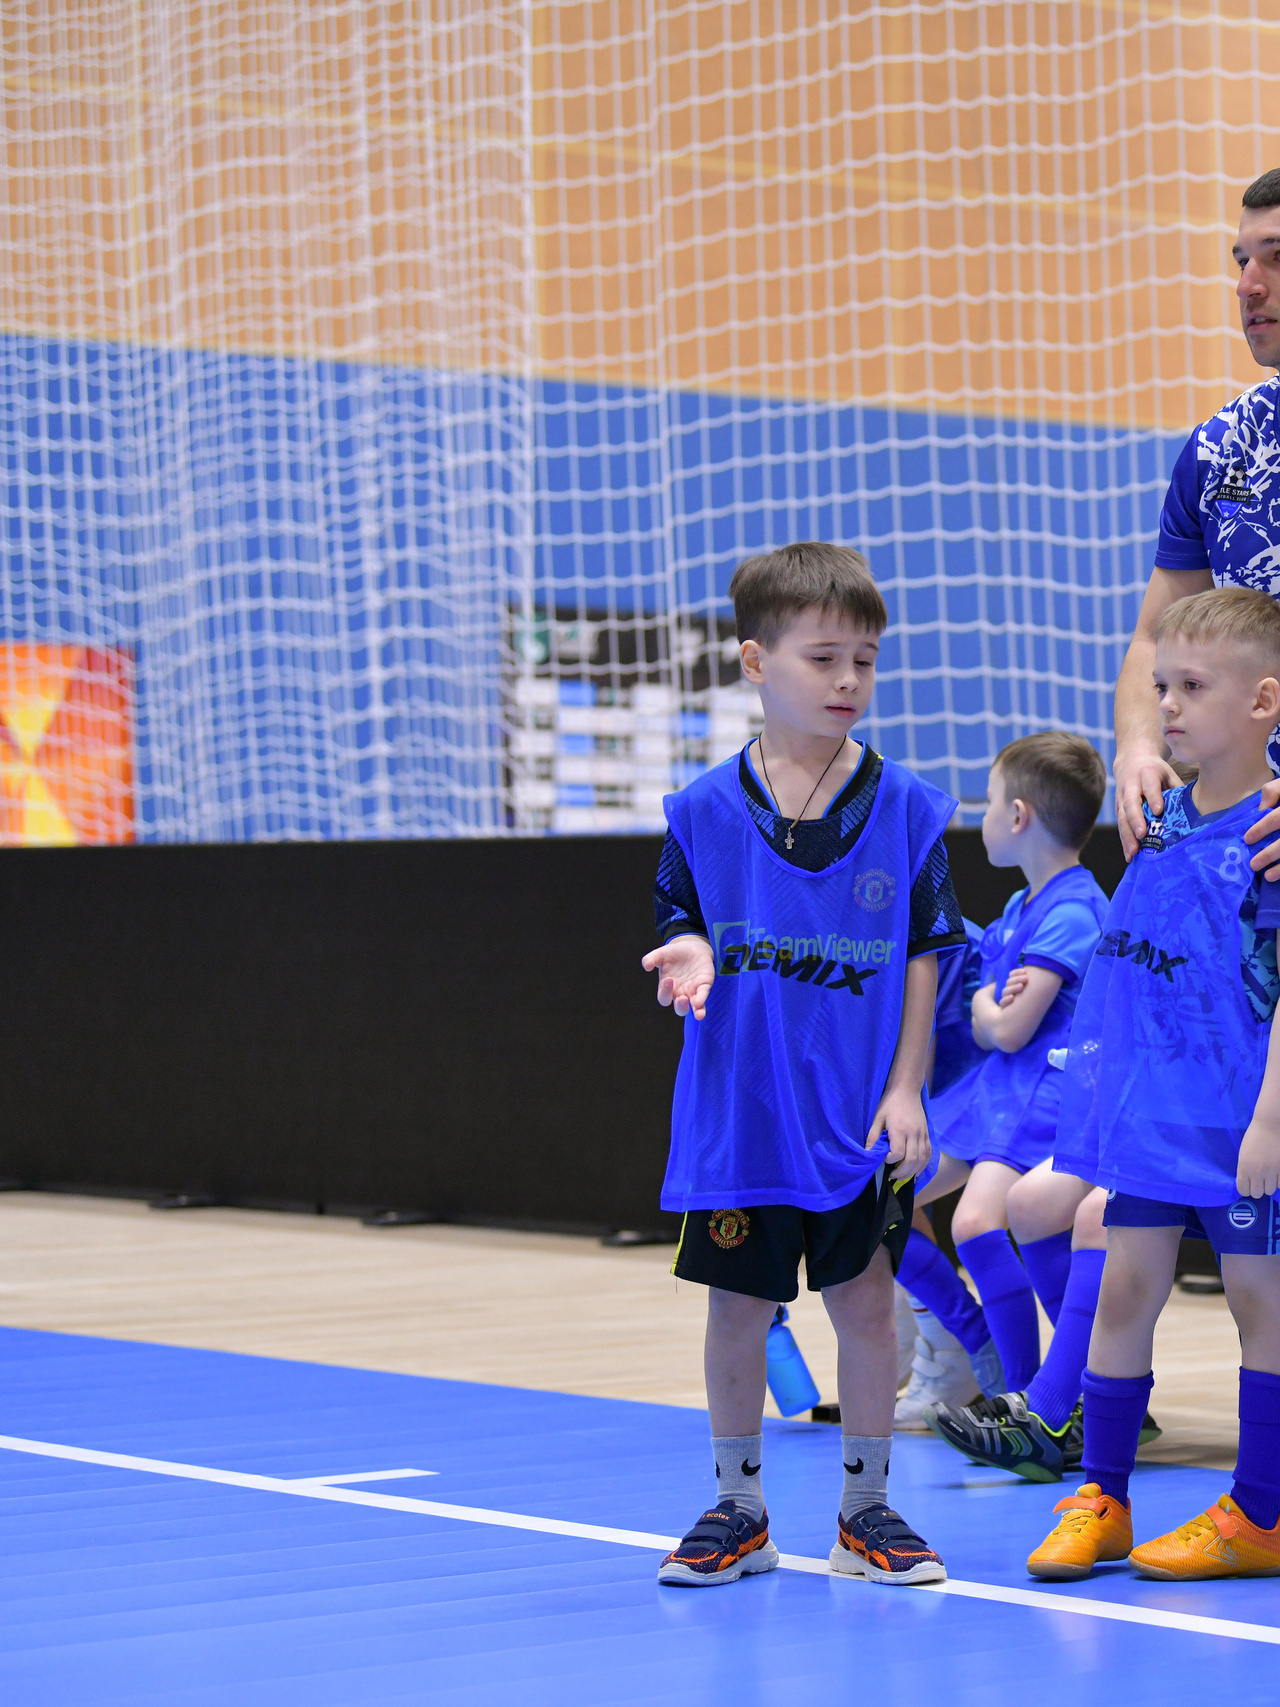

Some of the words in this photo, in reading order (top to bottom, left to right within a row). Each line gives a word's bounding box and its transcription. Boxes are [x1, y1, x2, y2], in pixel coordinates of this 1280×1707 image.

[1218, 846, 1242, 882] 8
[720, 941, 878, 996] DEMIX
[714, 1235, 738, 1246] UNITED
